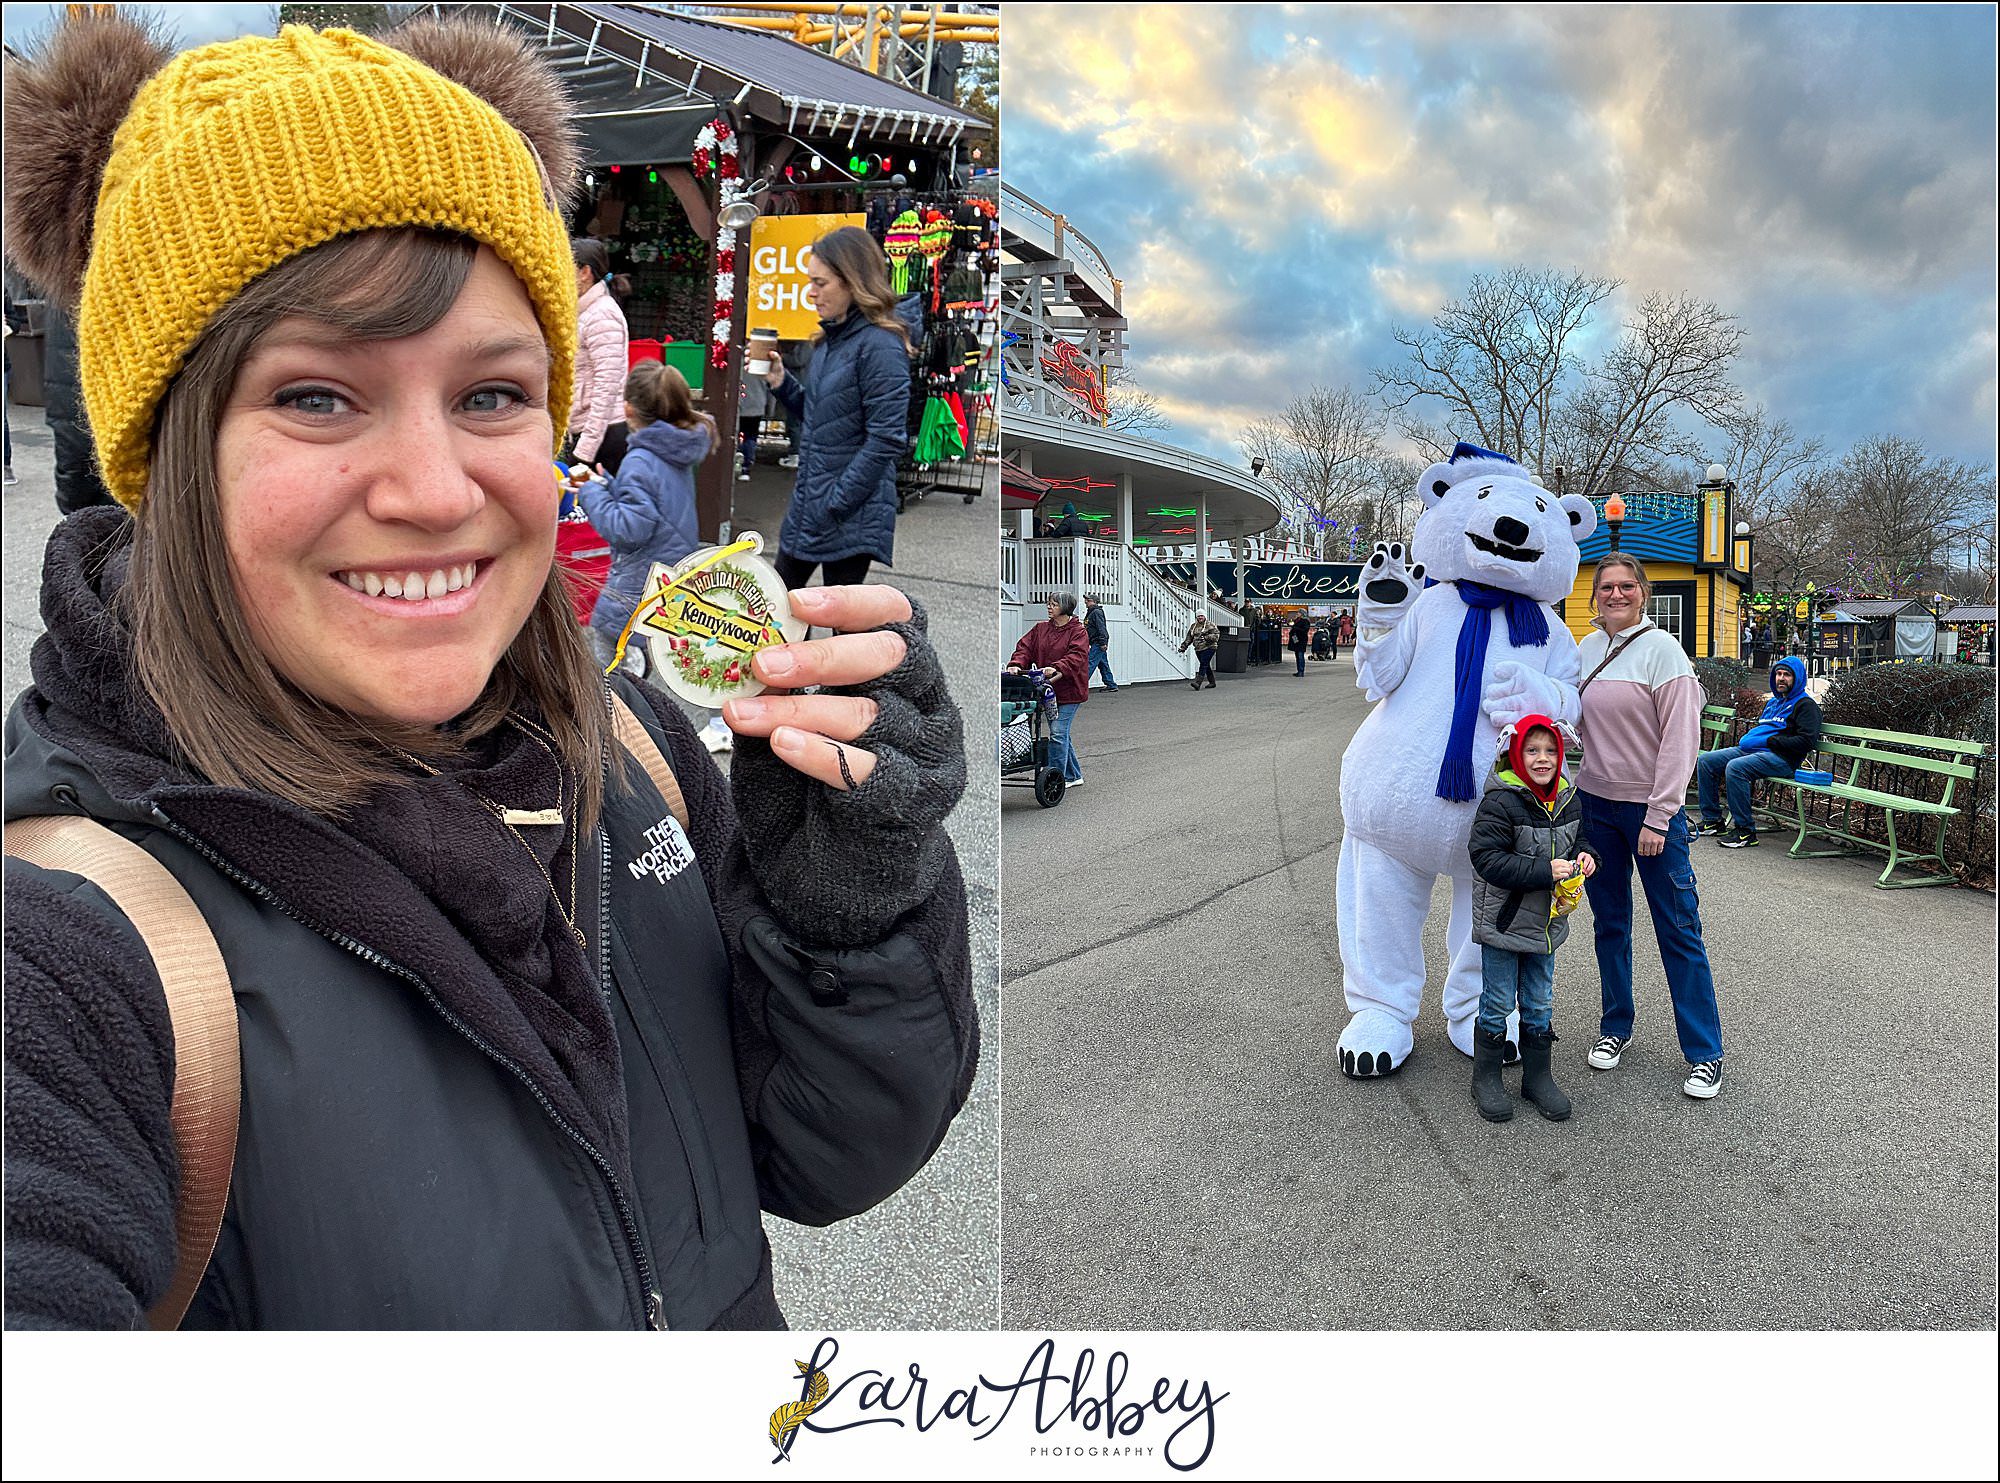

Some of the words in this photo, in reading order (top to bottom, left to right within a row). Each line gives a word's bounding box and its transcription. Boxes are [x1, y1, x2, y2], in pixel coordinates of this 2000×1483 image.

[754, 245, 813, 274] GLO
[757, 283, 818, 311] SHO
[694, 571, 740, 595] HOLIDAY
[738, 578, 767, 616] LIGHTS
[679, 600, 761, 646] Kennywood
[642, 818, 673, 848] THE
[627, 833, 681, 880] NORTH
[653, 849, 689, 885] FACE
